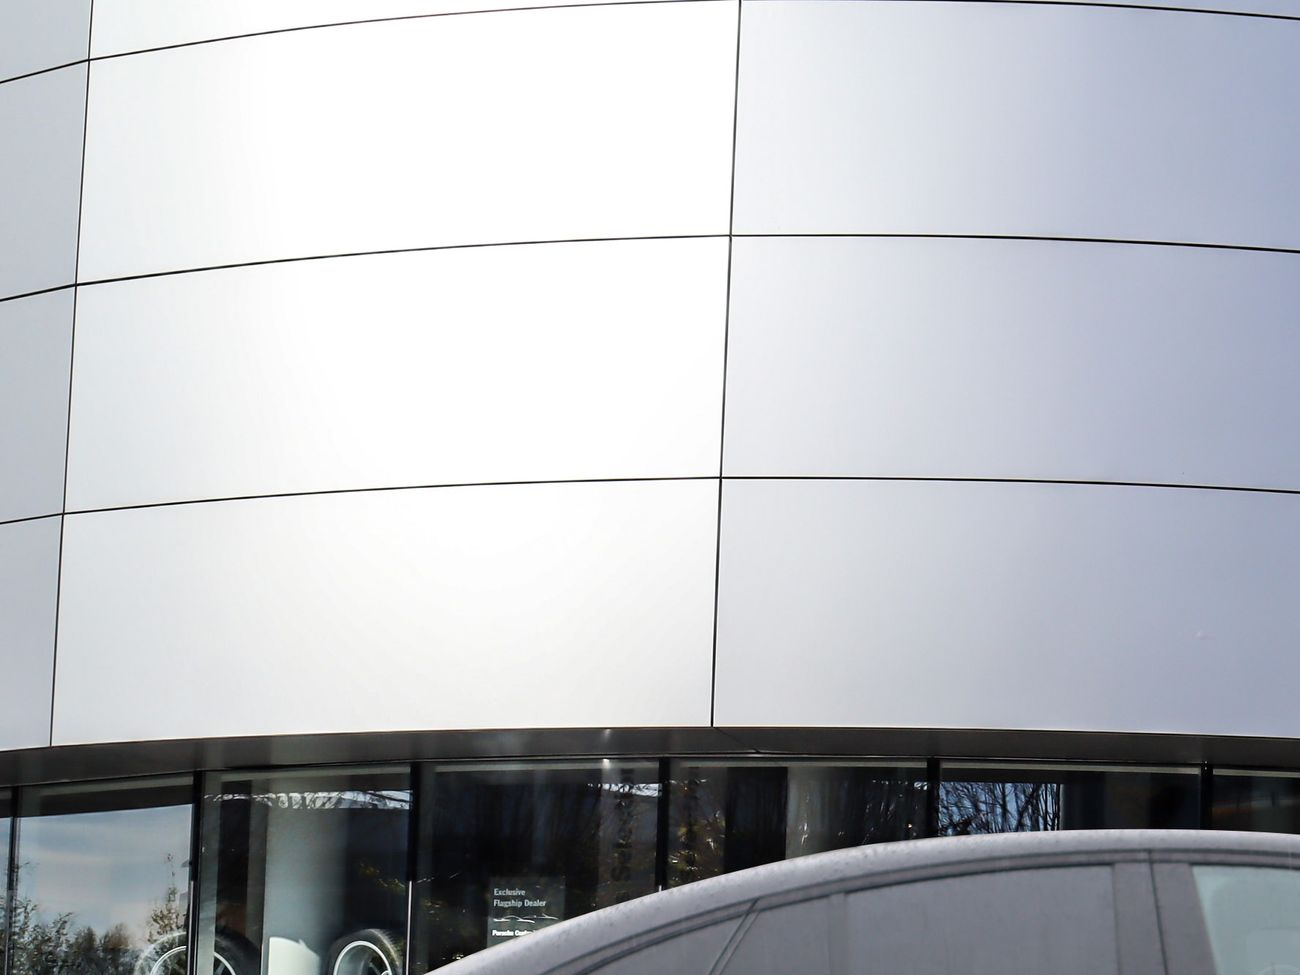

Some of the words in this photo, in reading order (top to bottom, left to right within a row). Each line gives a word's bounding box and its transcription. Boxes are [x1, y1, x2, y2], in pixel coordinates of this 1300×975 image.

[493, 888, 526, 896] Exclusive
[493, 899, 523, 908] Flagship
[524, 899, 547, 907] Dealer
